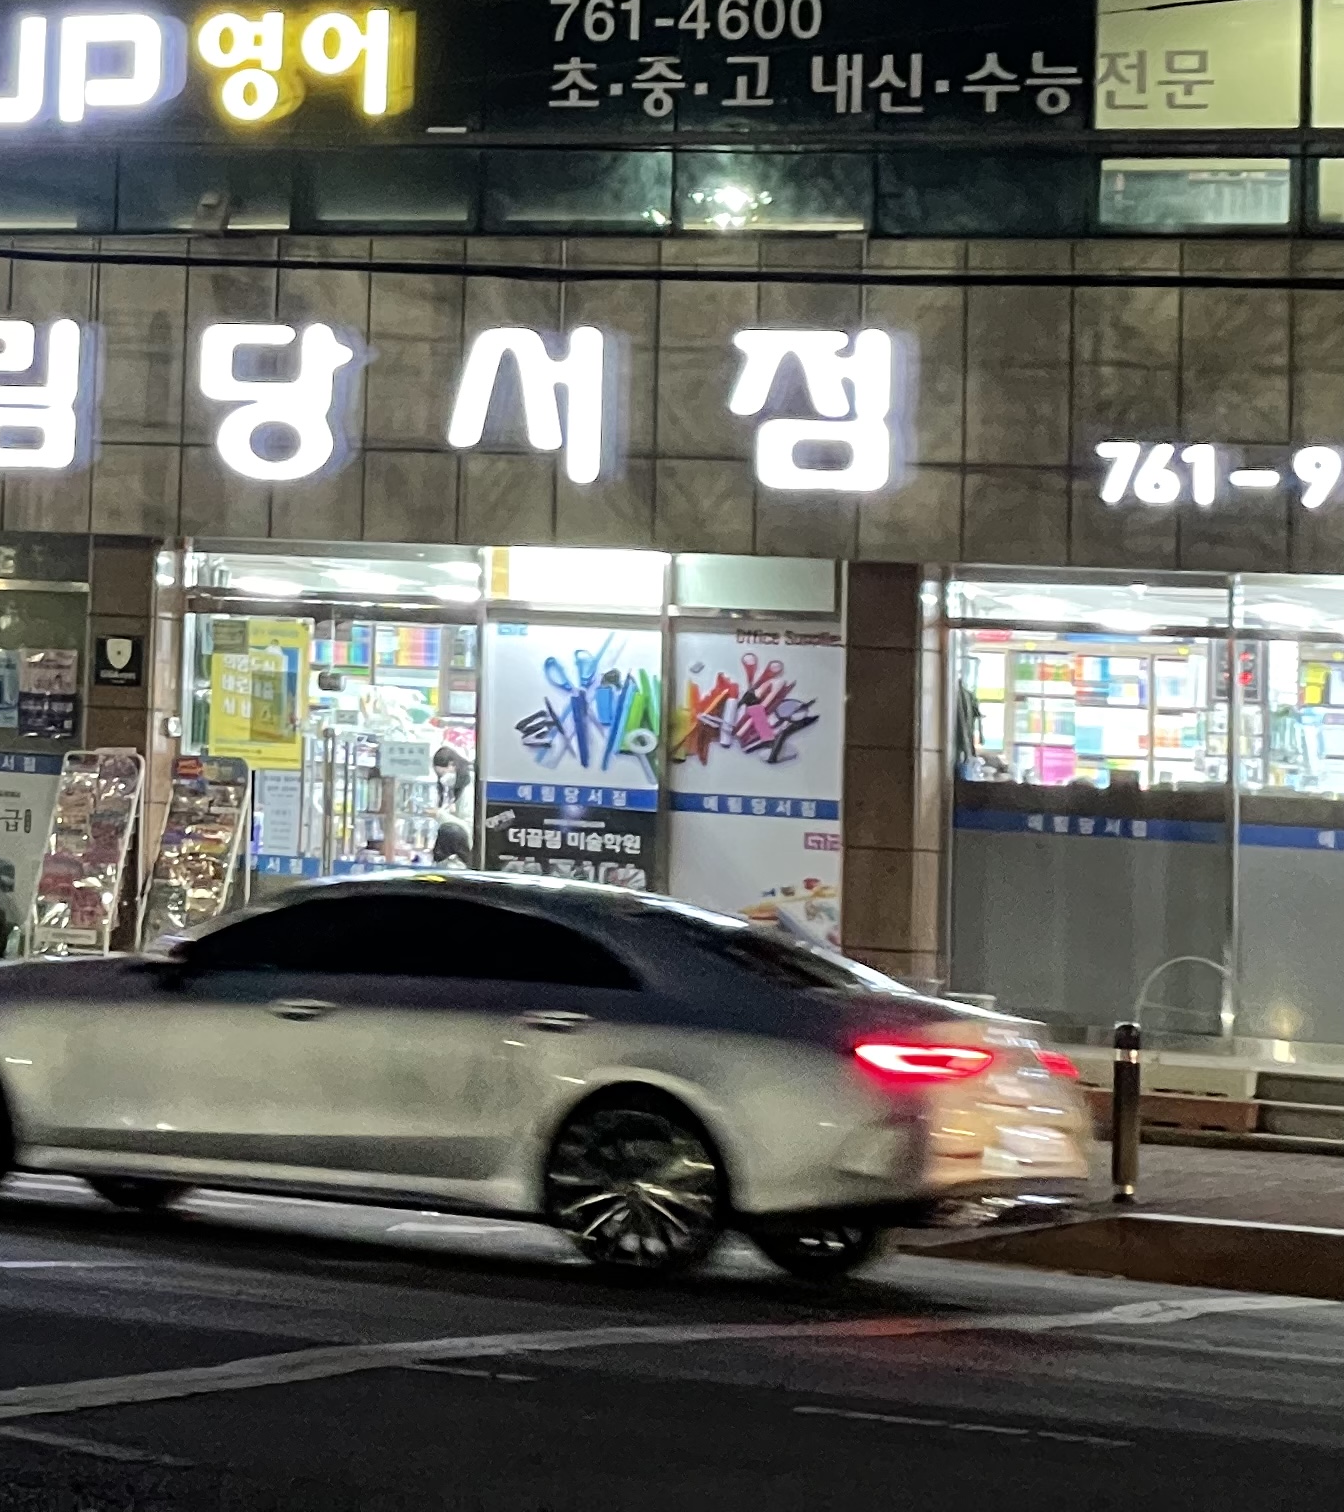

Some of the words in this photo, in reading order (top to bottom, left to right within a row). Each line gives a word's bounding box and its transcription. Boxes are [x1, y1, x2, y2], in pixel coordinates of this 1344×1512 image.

[197, 8, 392, 122] 영어
[546, 54, 775, 118] 초·중·고
[566, 830, 641, 855] 미술학원
